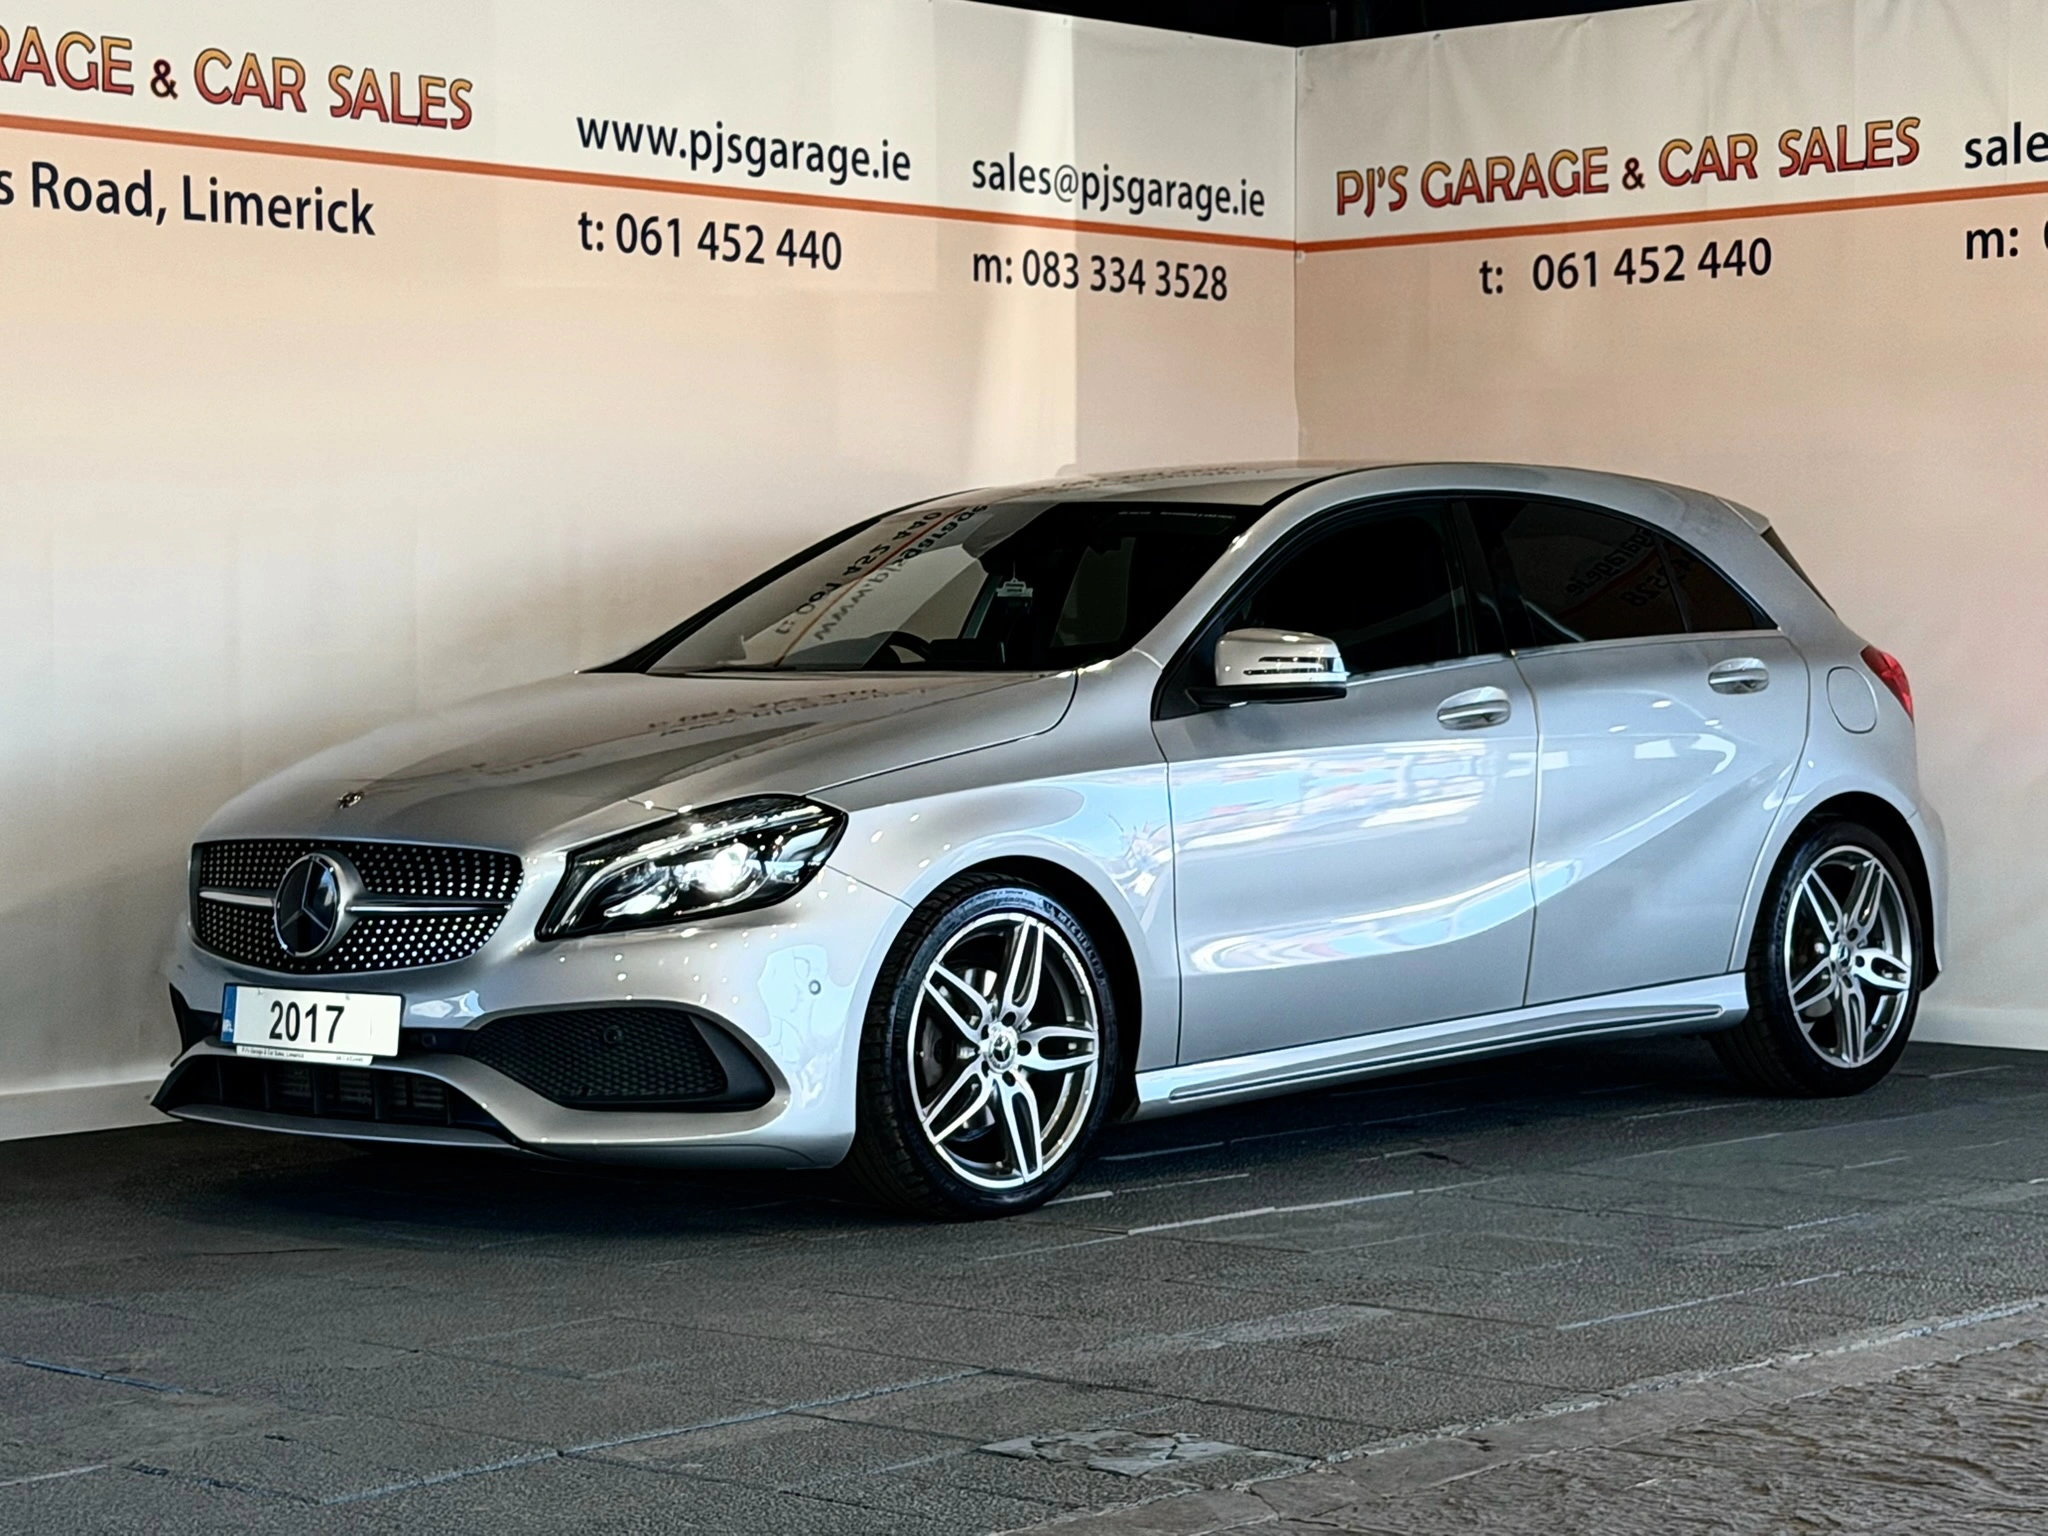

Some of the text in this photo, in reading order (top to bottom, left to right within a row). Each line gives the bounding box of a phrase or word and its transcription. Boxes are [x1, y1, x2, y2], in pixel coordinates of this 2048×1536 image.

[150, 58, 178, 100] &
[194, 48, 307, 113] CAR
[328, 65, 473, 130] SALES
[576, 117, 912, 185] www.pjsgarage.ie
[1336, 116, 1922, 218] PJ'S GARAGE & CAR SALES
[32, 161, 167, 226] Road,
[183, 168, 376, 236] Limerick
[972, 152, 1265, 222] sales@pjsgarage.ie
[578, 211, 842, 271] t: 061 452 440
[1479, 236, 1772, 295] t: 061 452 440
[1966, 226, 2019, 260] m:
[973, 248, 1228, 302] m: 083 334 3528
[269, 1000, 344, 1044] 2017
